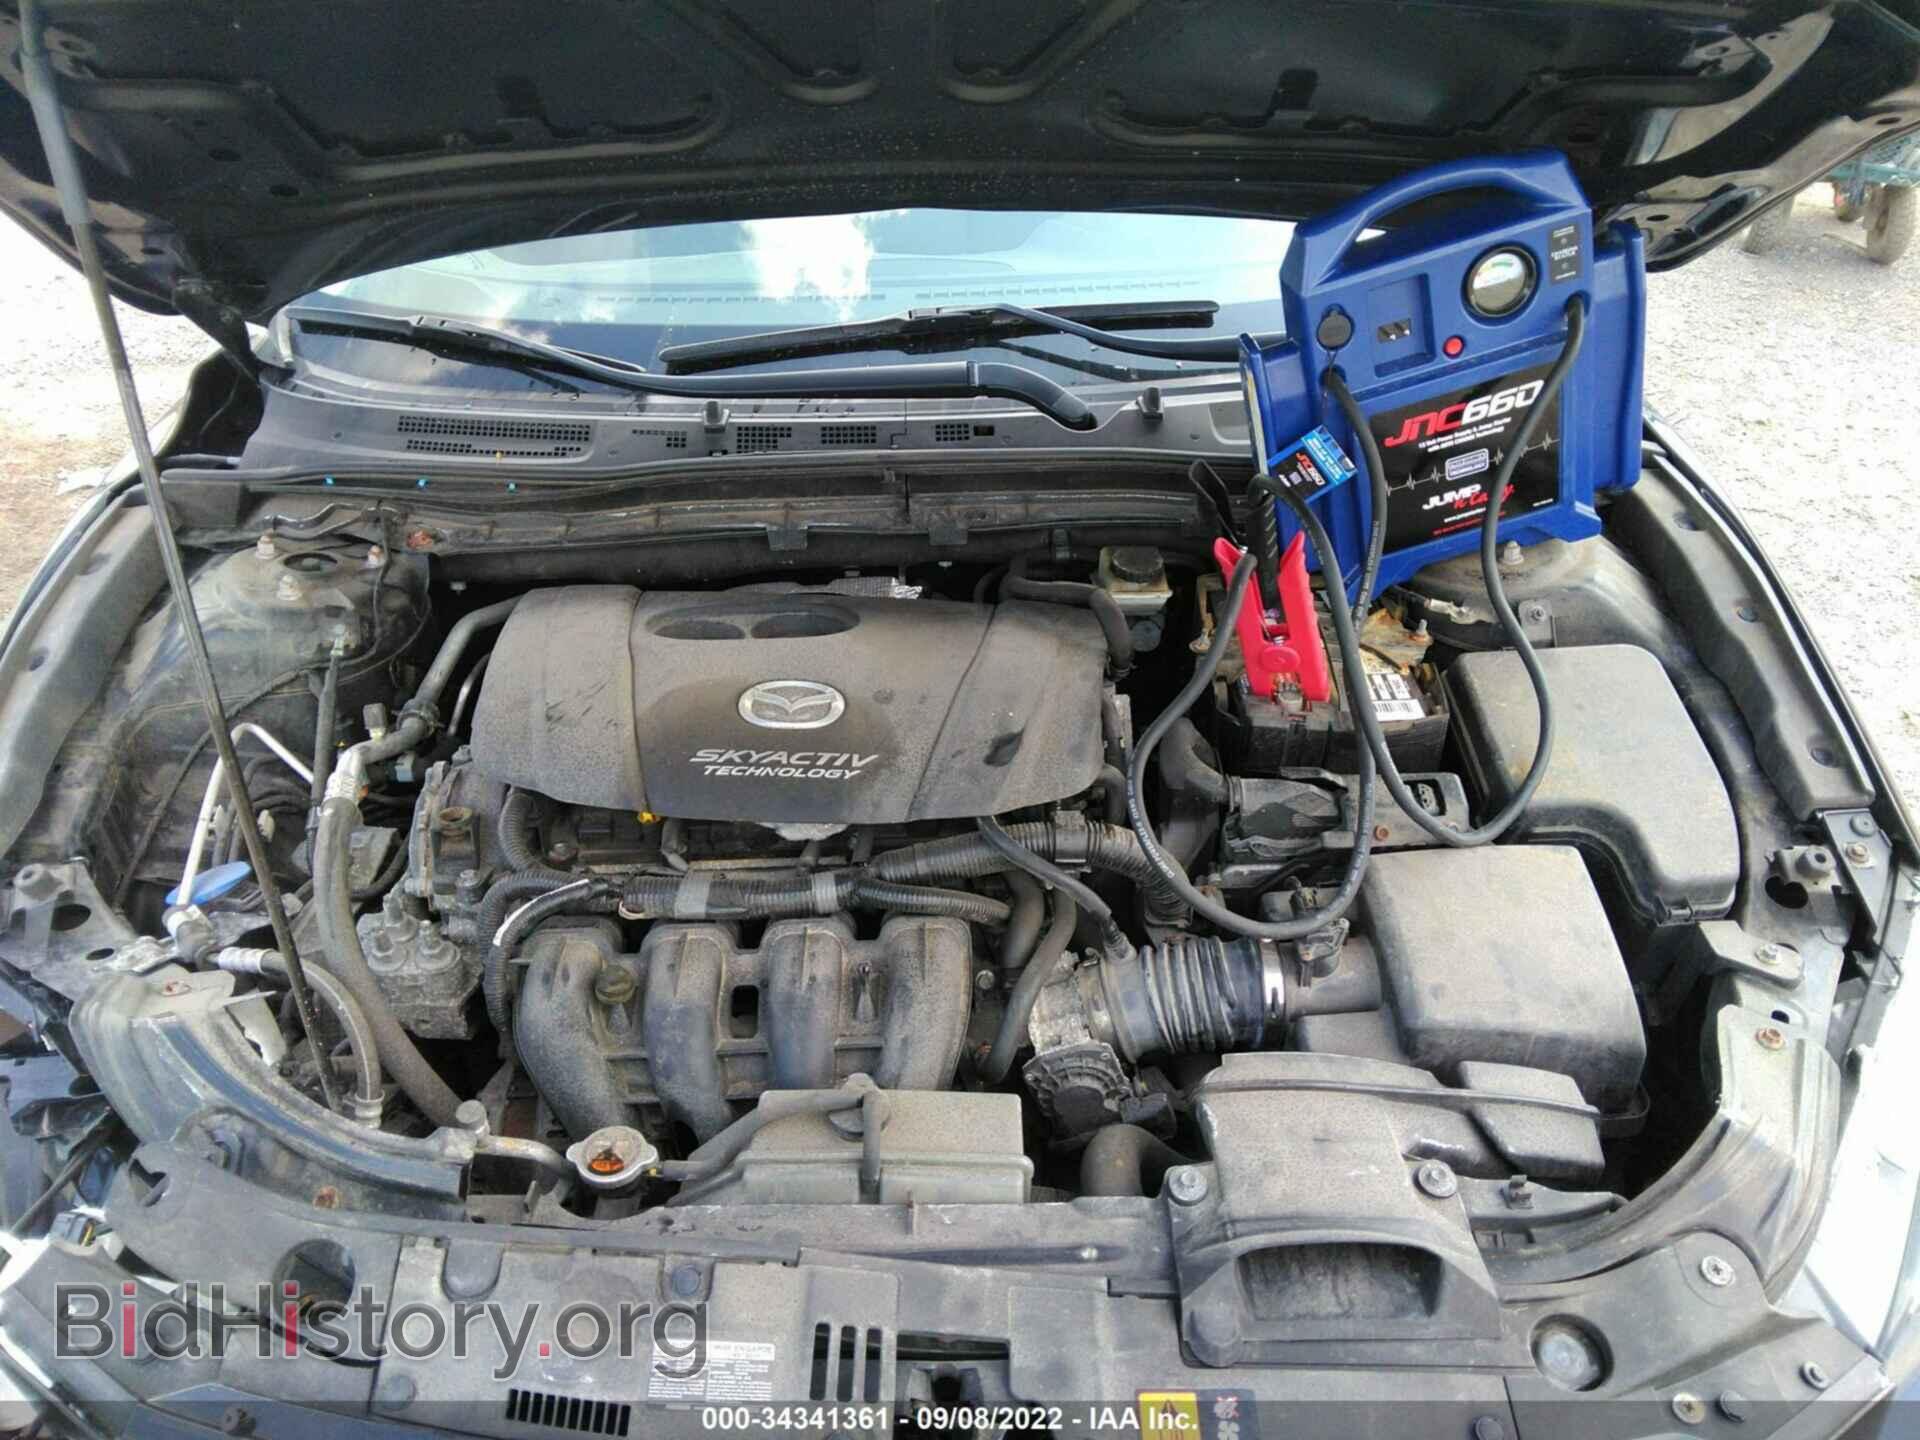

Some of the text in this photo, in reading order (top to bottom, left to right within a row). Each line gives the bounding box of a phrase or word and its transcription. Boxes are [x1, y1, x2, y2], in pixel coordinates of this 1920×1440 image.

[1384, 379, 1544, 447] JNC660
[1422, 483, 1481, 510] JUMP
[689, 749, 879, 767] SKYACTIV
[703, 765, 861, 780] TECHNOLOGY
